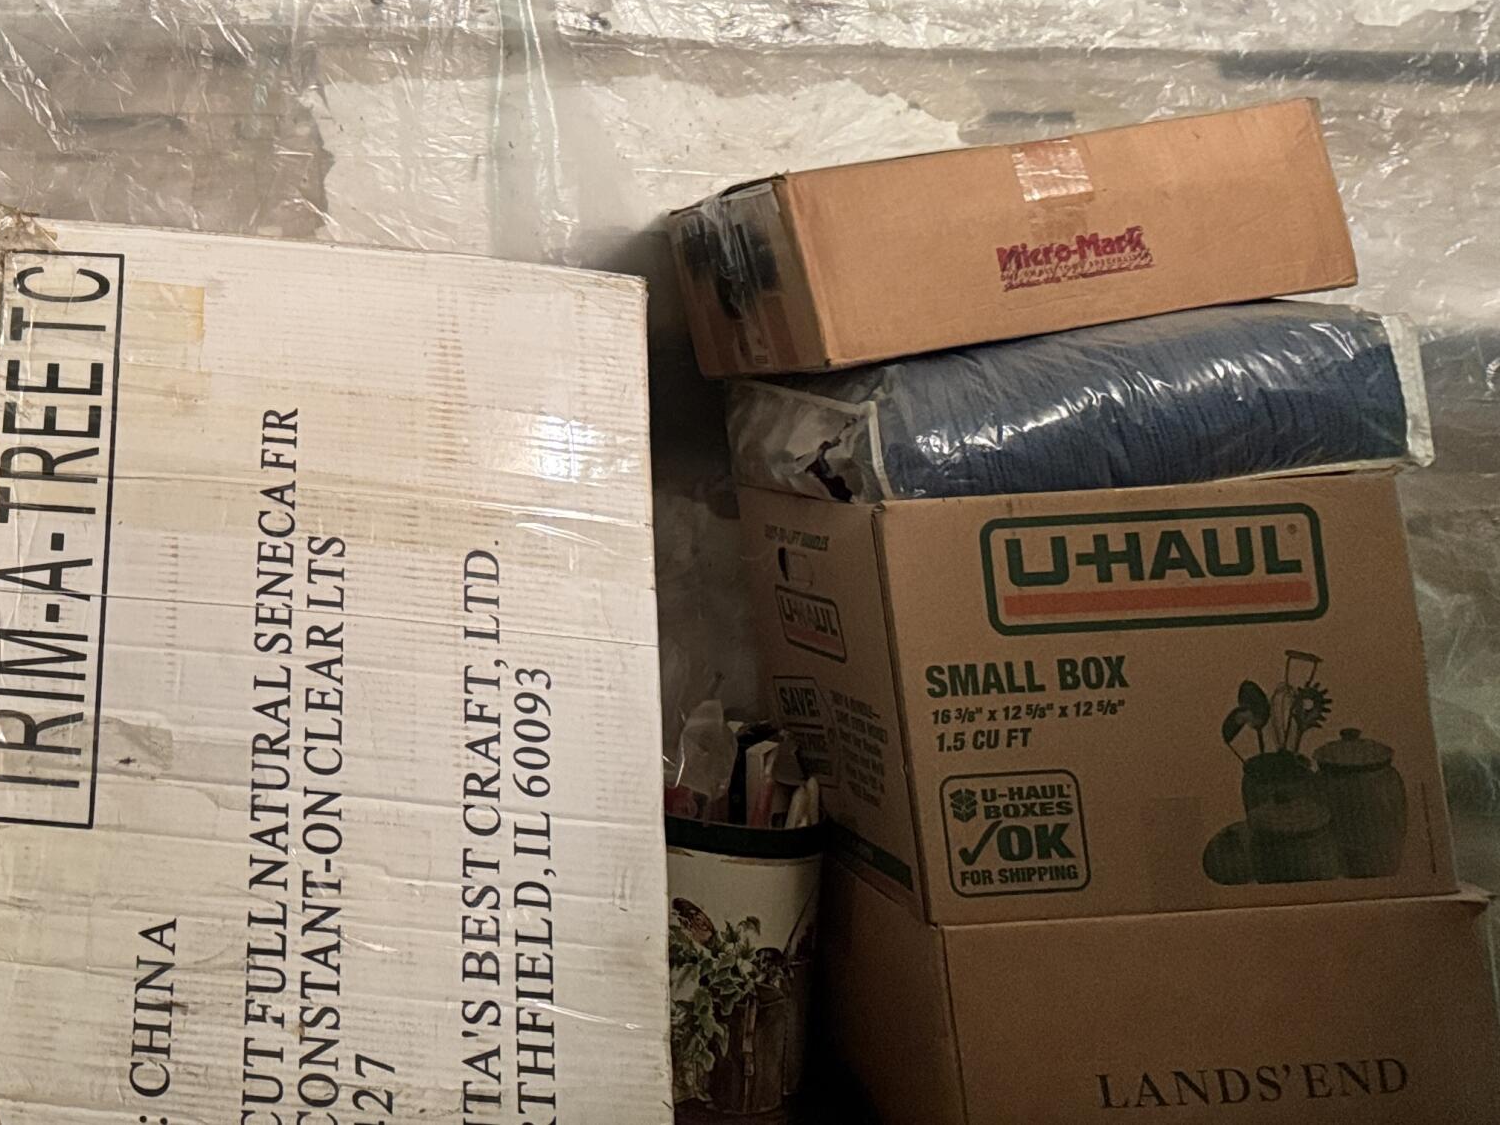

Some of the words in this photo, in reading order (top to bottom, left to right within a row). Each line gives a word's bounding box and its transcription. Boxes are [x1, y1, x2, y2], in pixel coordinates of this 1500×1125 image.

[996, 226, 1146, 271] Micro-Mark
[10, 266, 110, 341] TC
[260, 408, 298, 473] FIR
[253, 480, 296, 654] SENECA
[307, 536, 346, 611] LTS
[464, 540, 501, 644] LTD.
[1005, 525, 1302, 588] U-HAUL
[303, 621, 344, 775] CLEAR
[778, 687, 821, 717] SAVE!
[925, 660, 1046, 698] SMALL
[1057, 655, 1130, 691] BOX
[932, 709, 950, 724] 16
[987, 711, 997, 721] x
[1003, 705, 1021, 721] 12
[1058, 707, 1068, 718] x
[1073, 701, 1093, 717] 12
[462, 659, 509, 836] CRAFT,
[512, 668, 552, 798] 60093
[937, 732, 965, 752] 1.5
[972, 729, 999, 750] CU
[1006, 728, 1032, 748] FT
[249, 665, 292, 891] NATURAL
[981, 784, 1071, 802] U-HAUL
[984, 801, 1073, 820] BOXES
[960, 869, 994, 887] FOR
[998, 864, 1078, 885] SHIPPING
[997, 823, 1076, 862] OK
[462, 848, 501, 986] BEST
[244, 900, 288, 1028] FULL
[129, 918, 177, 1097] CHINA
[352, 1054, 396, 1125] 27
[461, 1000, 501, 1125] TA'S
